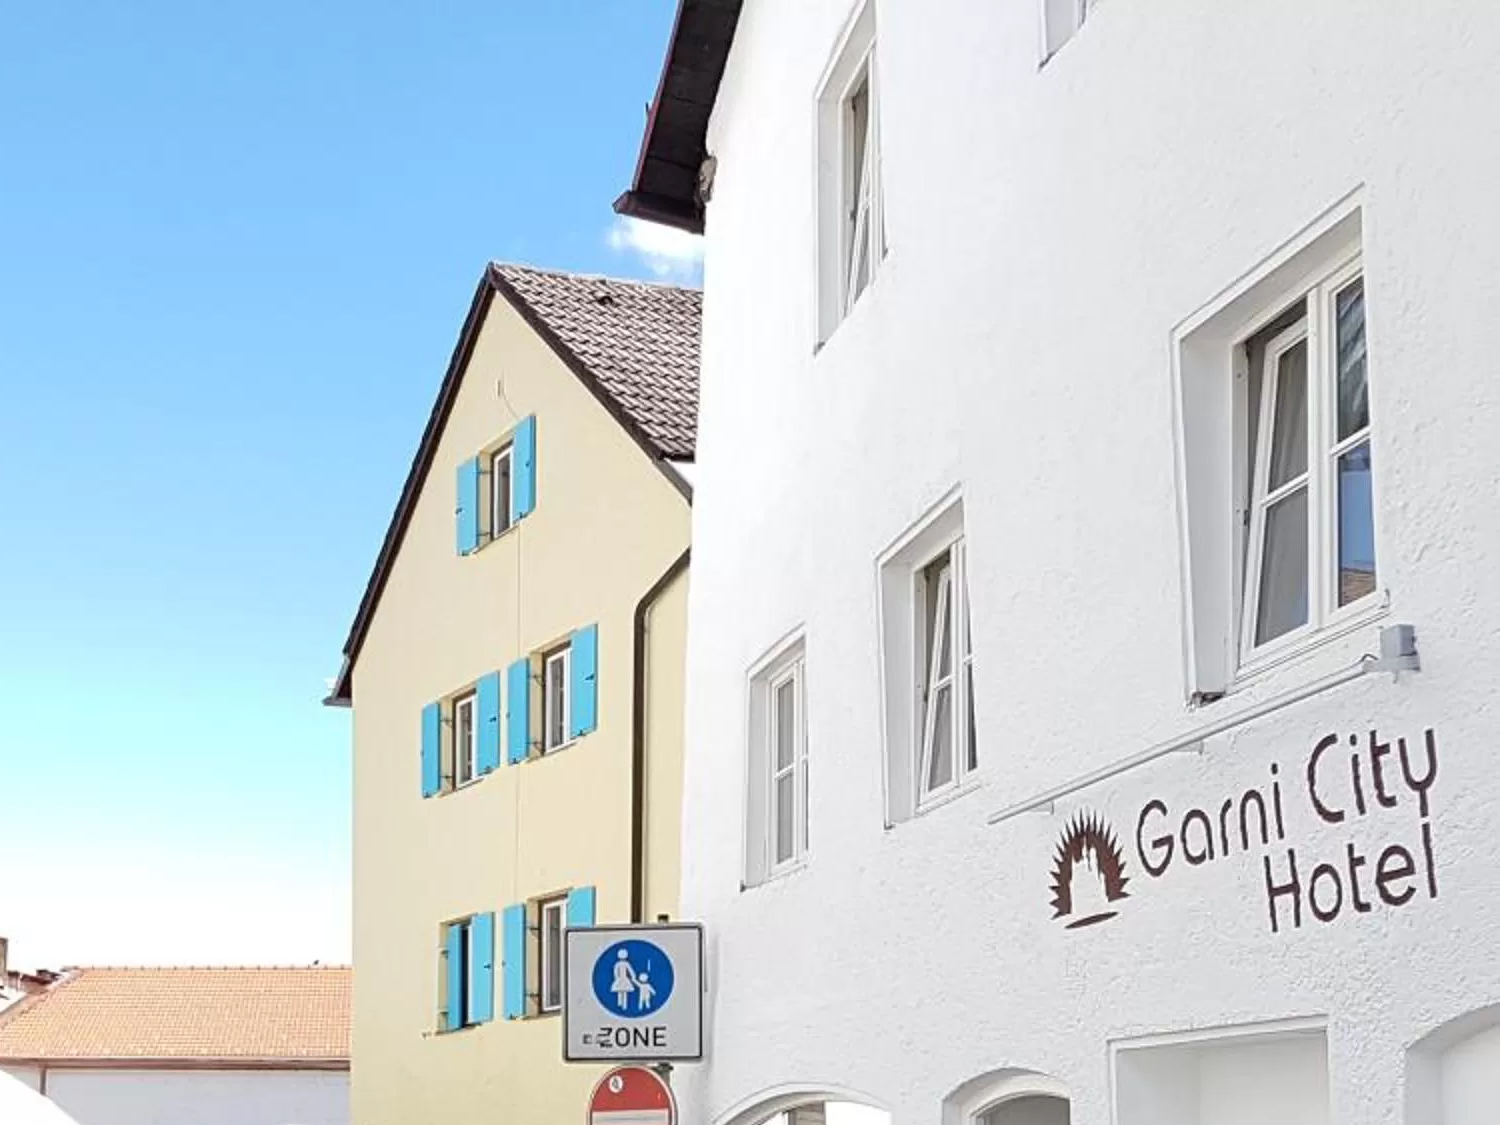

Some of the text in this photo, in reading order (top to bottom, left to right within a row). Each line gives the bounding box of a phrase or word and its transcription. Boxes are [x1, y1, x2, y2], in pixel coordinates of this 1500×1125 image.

[1137, 728, 1438, 878] Garni City
[1263, 822, 1438, 932] Hotel
